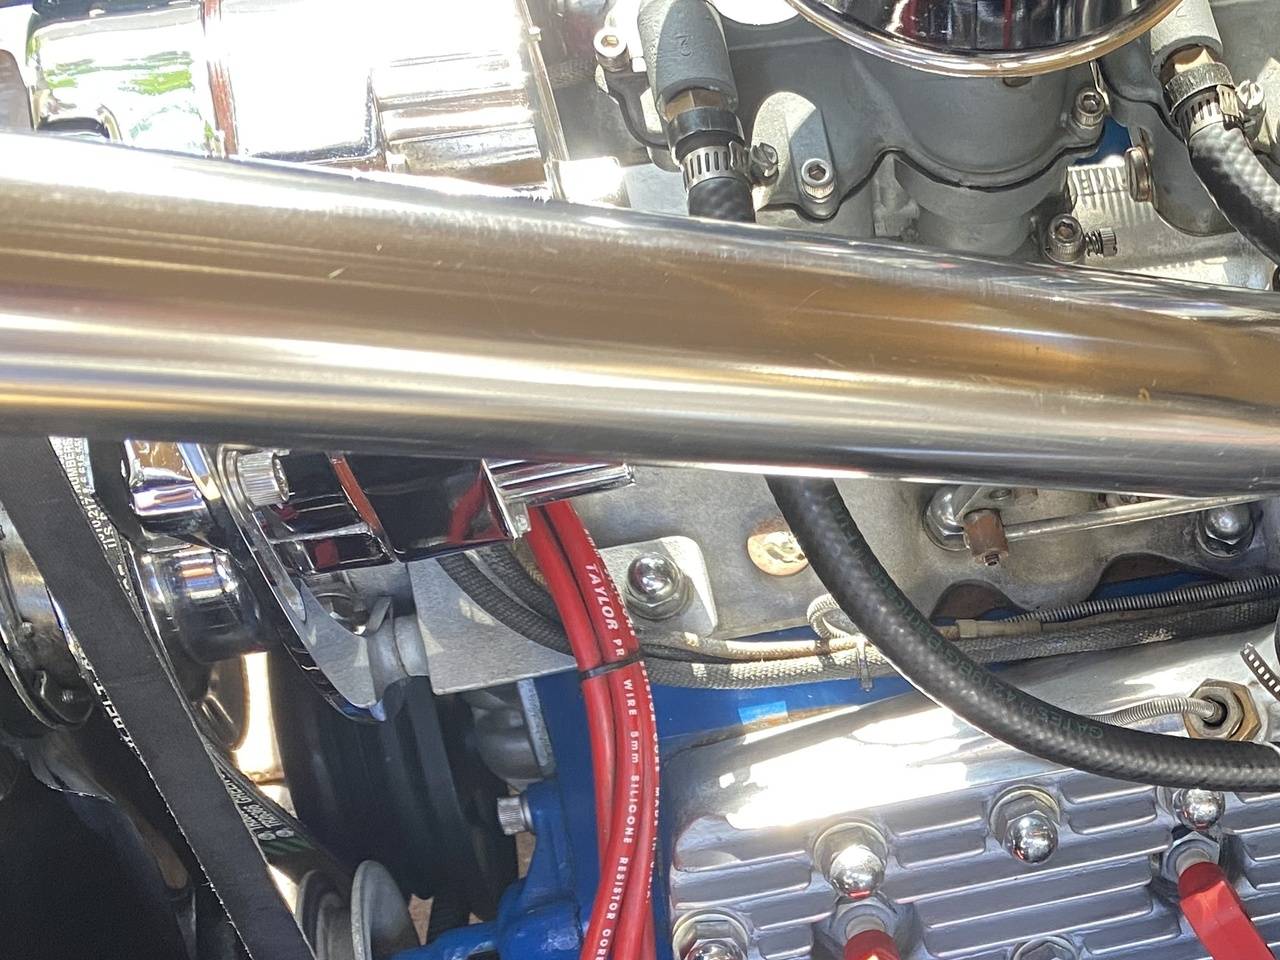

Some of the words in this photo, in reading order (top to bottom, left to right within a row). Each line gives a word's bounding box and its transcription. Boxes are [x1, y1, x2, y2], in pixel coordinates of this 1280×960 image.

[585, 563, 618, 630] TAYLOR
[611, 637, 625, 657] PR
[622, 678, 636, 716] WIRE
[629, 730, 641, 762] 8mm
[621, 774, 640, 843] SILICONE
[604, 856, 630, 920] RESISTOR
